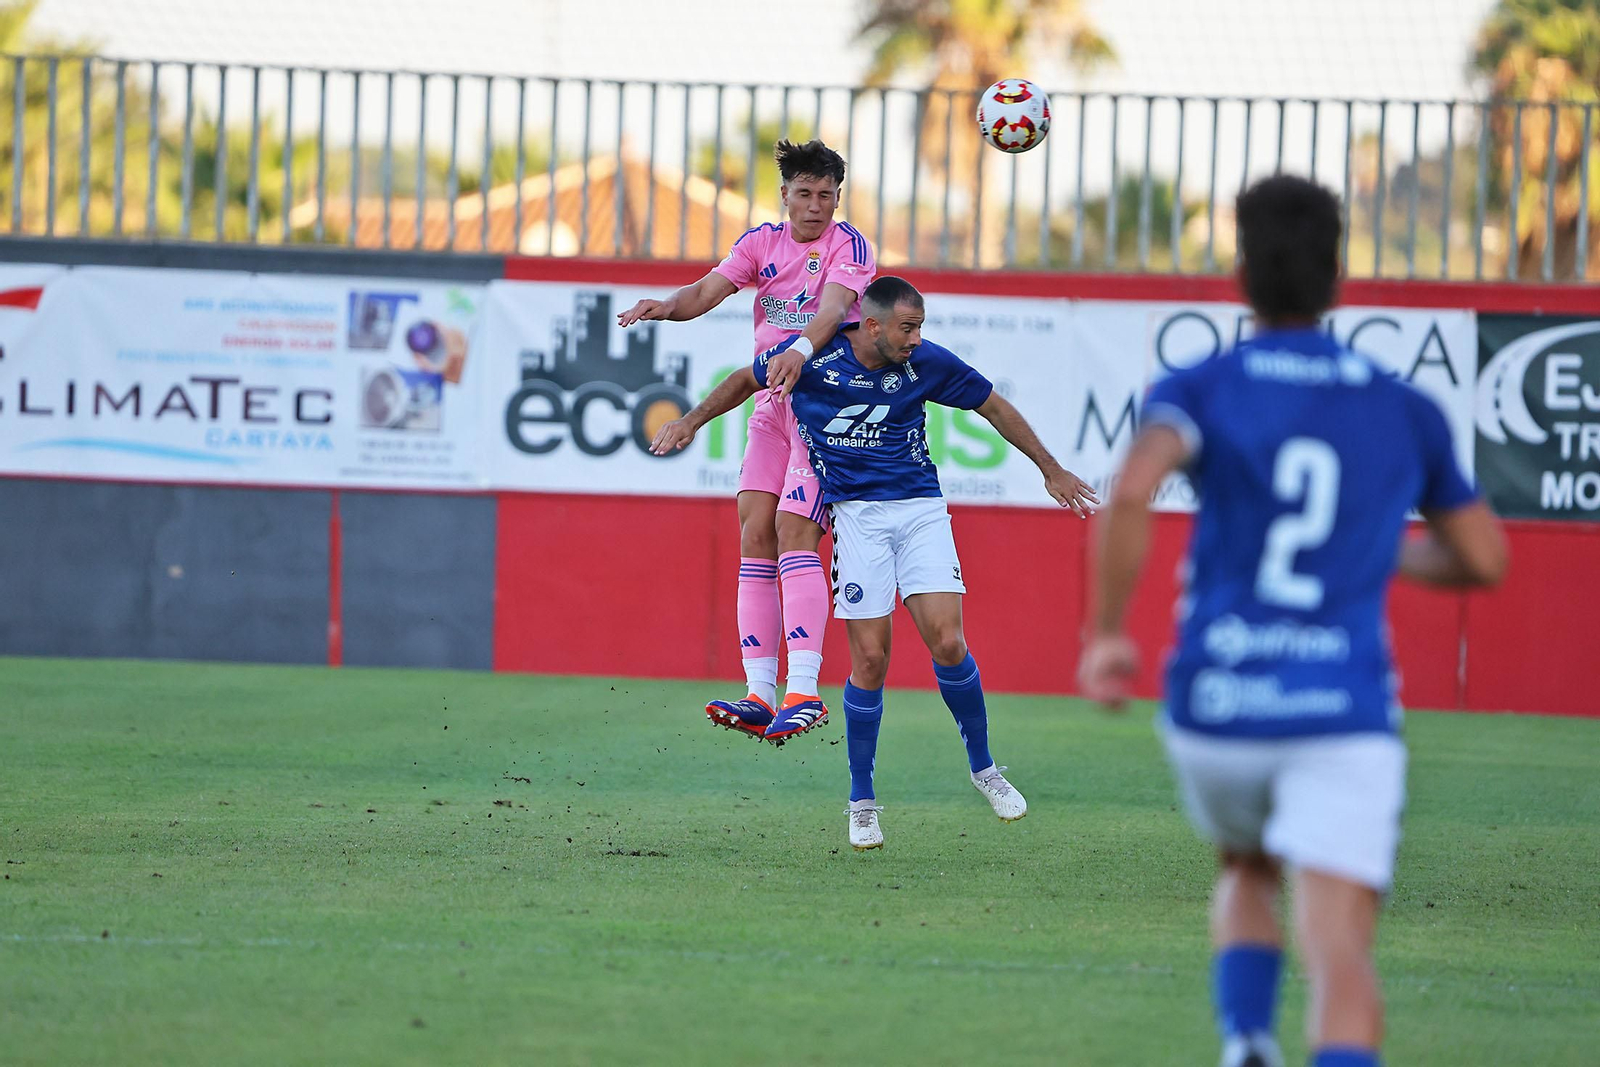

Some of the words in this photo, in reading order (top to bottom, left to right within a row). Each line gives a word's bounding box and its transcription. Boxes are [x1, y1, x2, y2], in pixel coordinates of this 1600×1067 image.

[760, 295, 788, 310] alter
[0, 345, 335, 424] LIMATEC
[205, 428, 334, 450] CARTAYA
[850, 422, 887, 438] Air
[827, 436, 883, 448] oneair.es
[1254, 436, 1341, 611] 2
